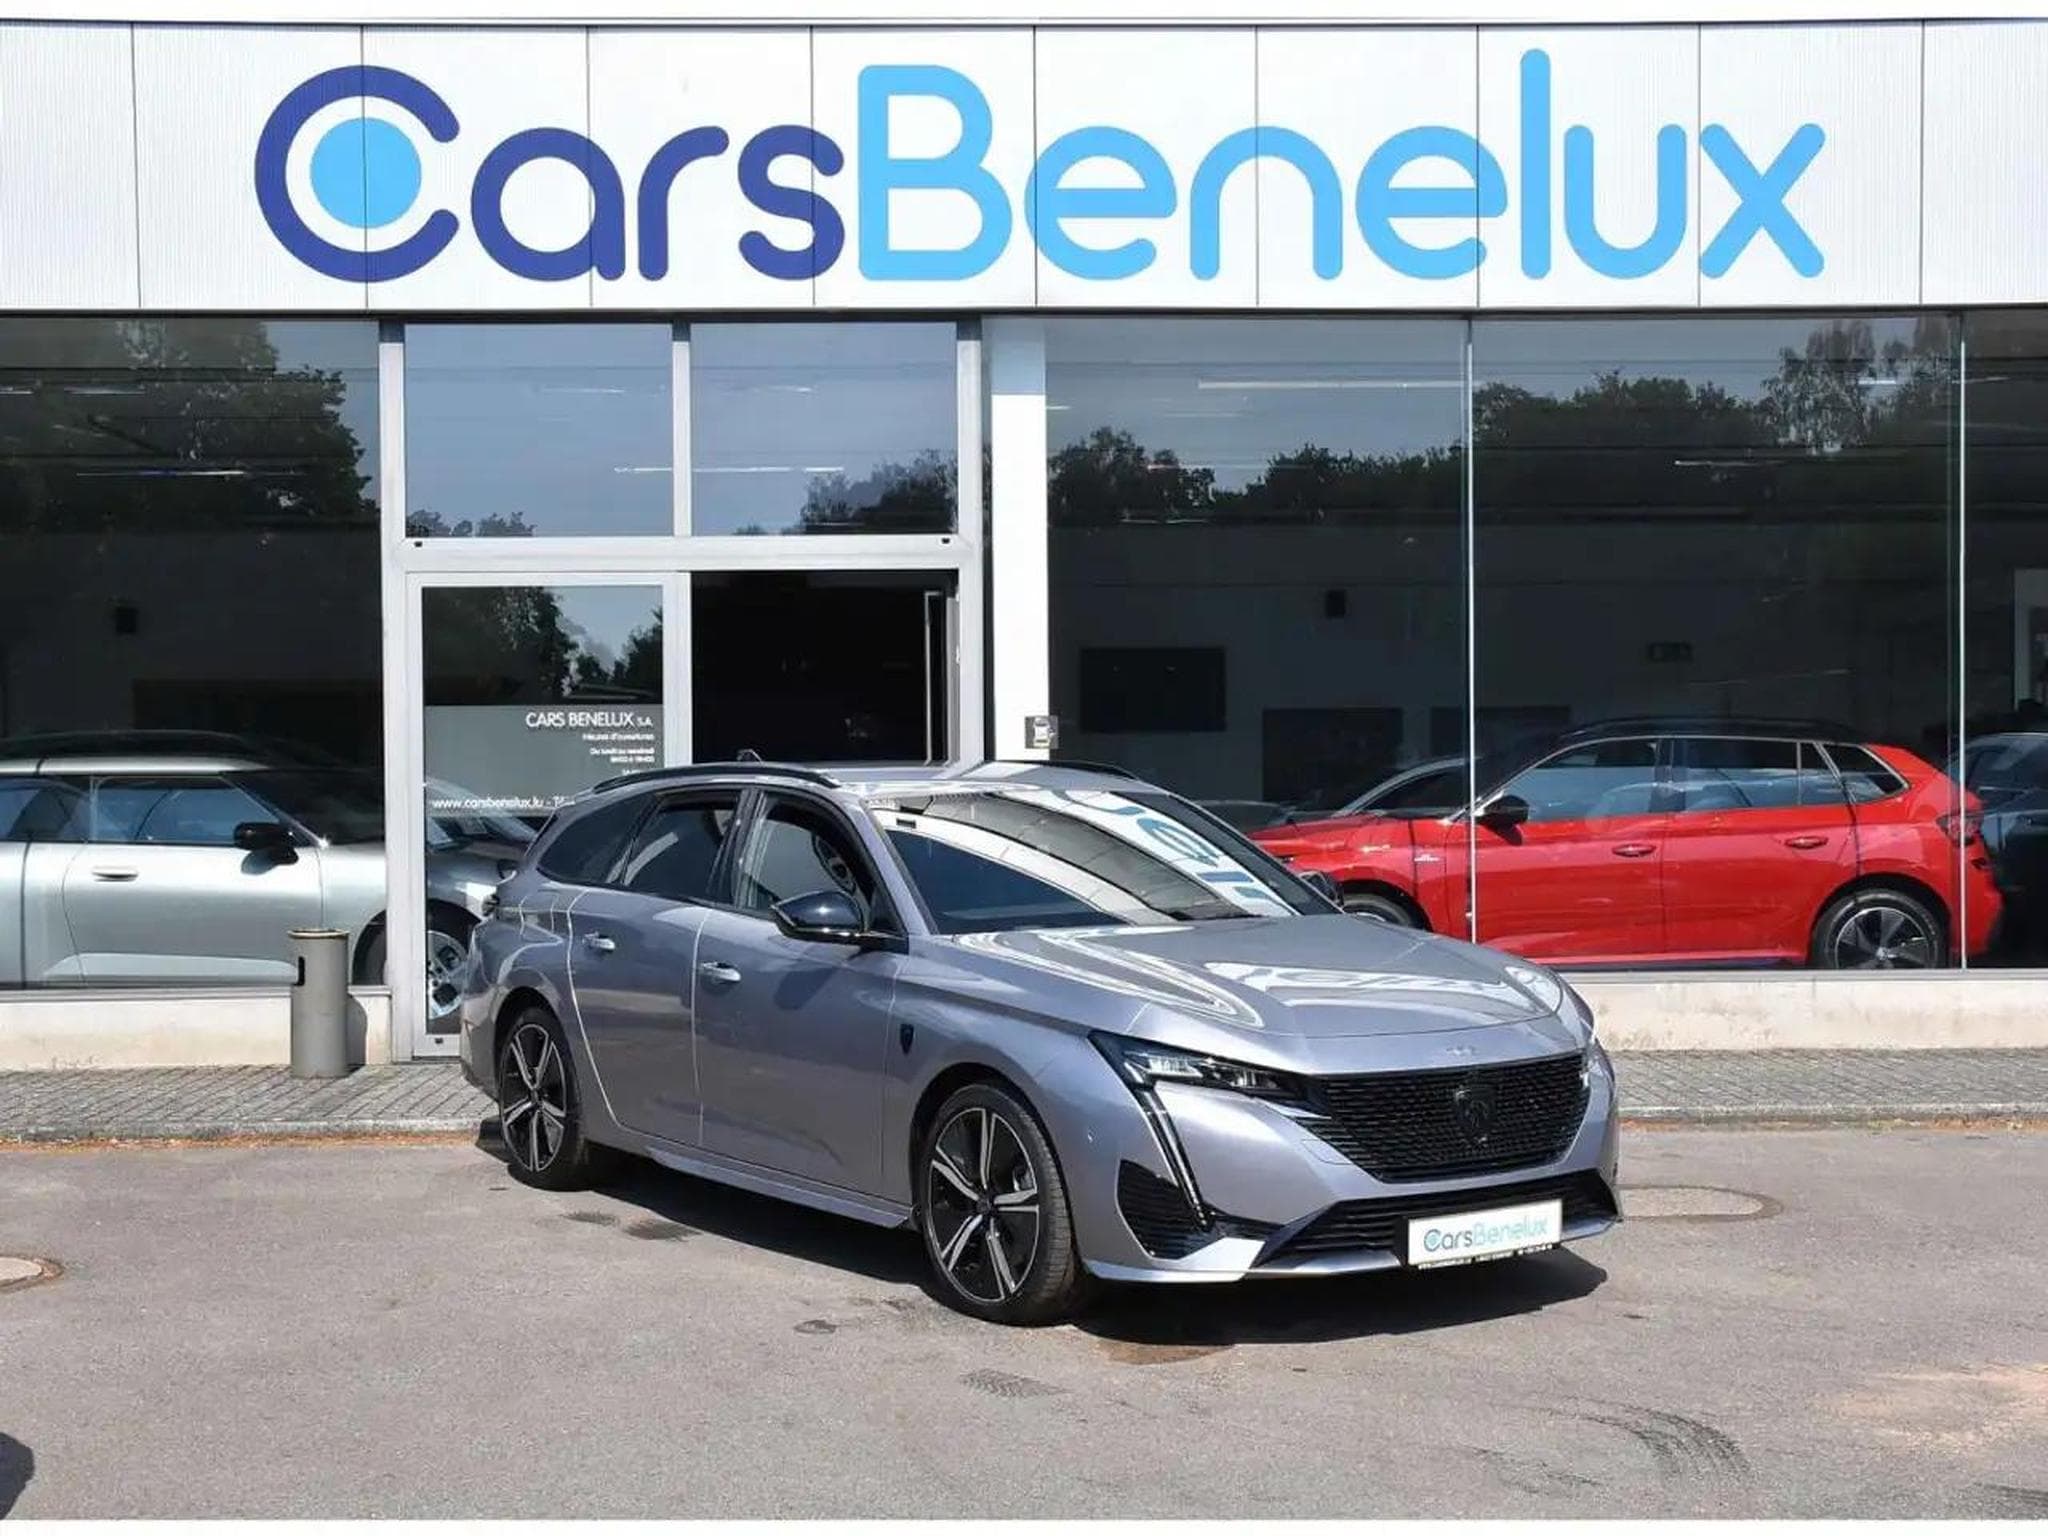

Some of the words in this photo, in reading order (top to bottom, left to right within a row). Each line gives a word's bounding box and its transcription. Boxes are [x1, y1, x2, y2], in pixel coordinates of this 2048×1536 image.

[256, 50, 1825, 283] CarsBenelux
[525, 711, 565, 728] CARS
[568, 711, 635, 728] BENELUX
[1423, 1214, 1549, 1252] CarsBenelux
